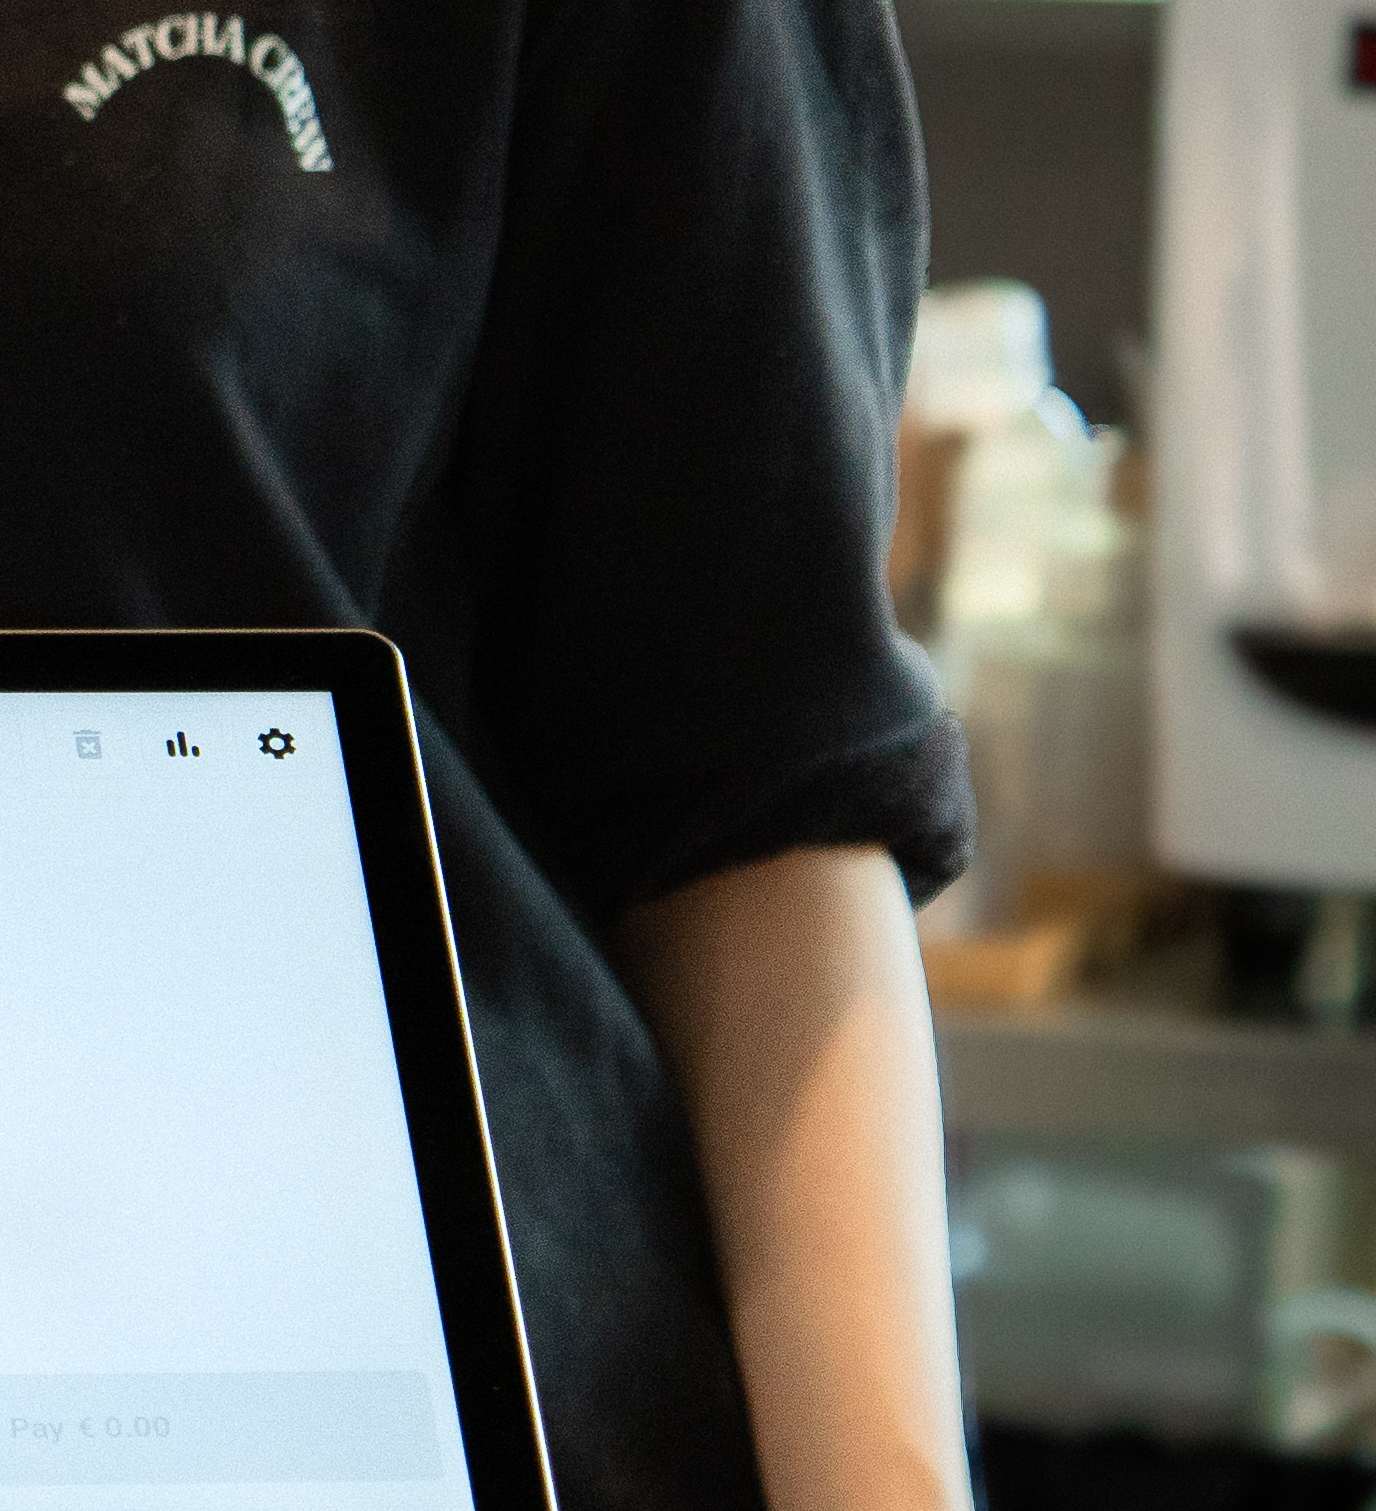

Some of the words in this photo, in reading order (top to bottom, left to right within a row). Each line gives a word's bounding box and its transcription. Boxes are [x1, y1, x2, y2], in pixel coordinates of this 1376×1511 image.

[63, 11, 245, 121] MATCHA
[10, 1416, 64, 1444] Pay
[78, 1416, 96, 1439] €
[104, 1415, 172, 1439] 0.00
